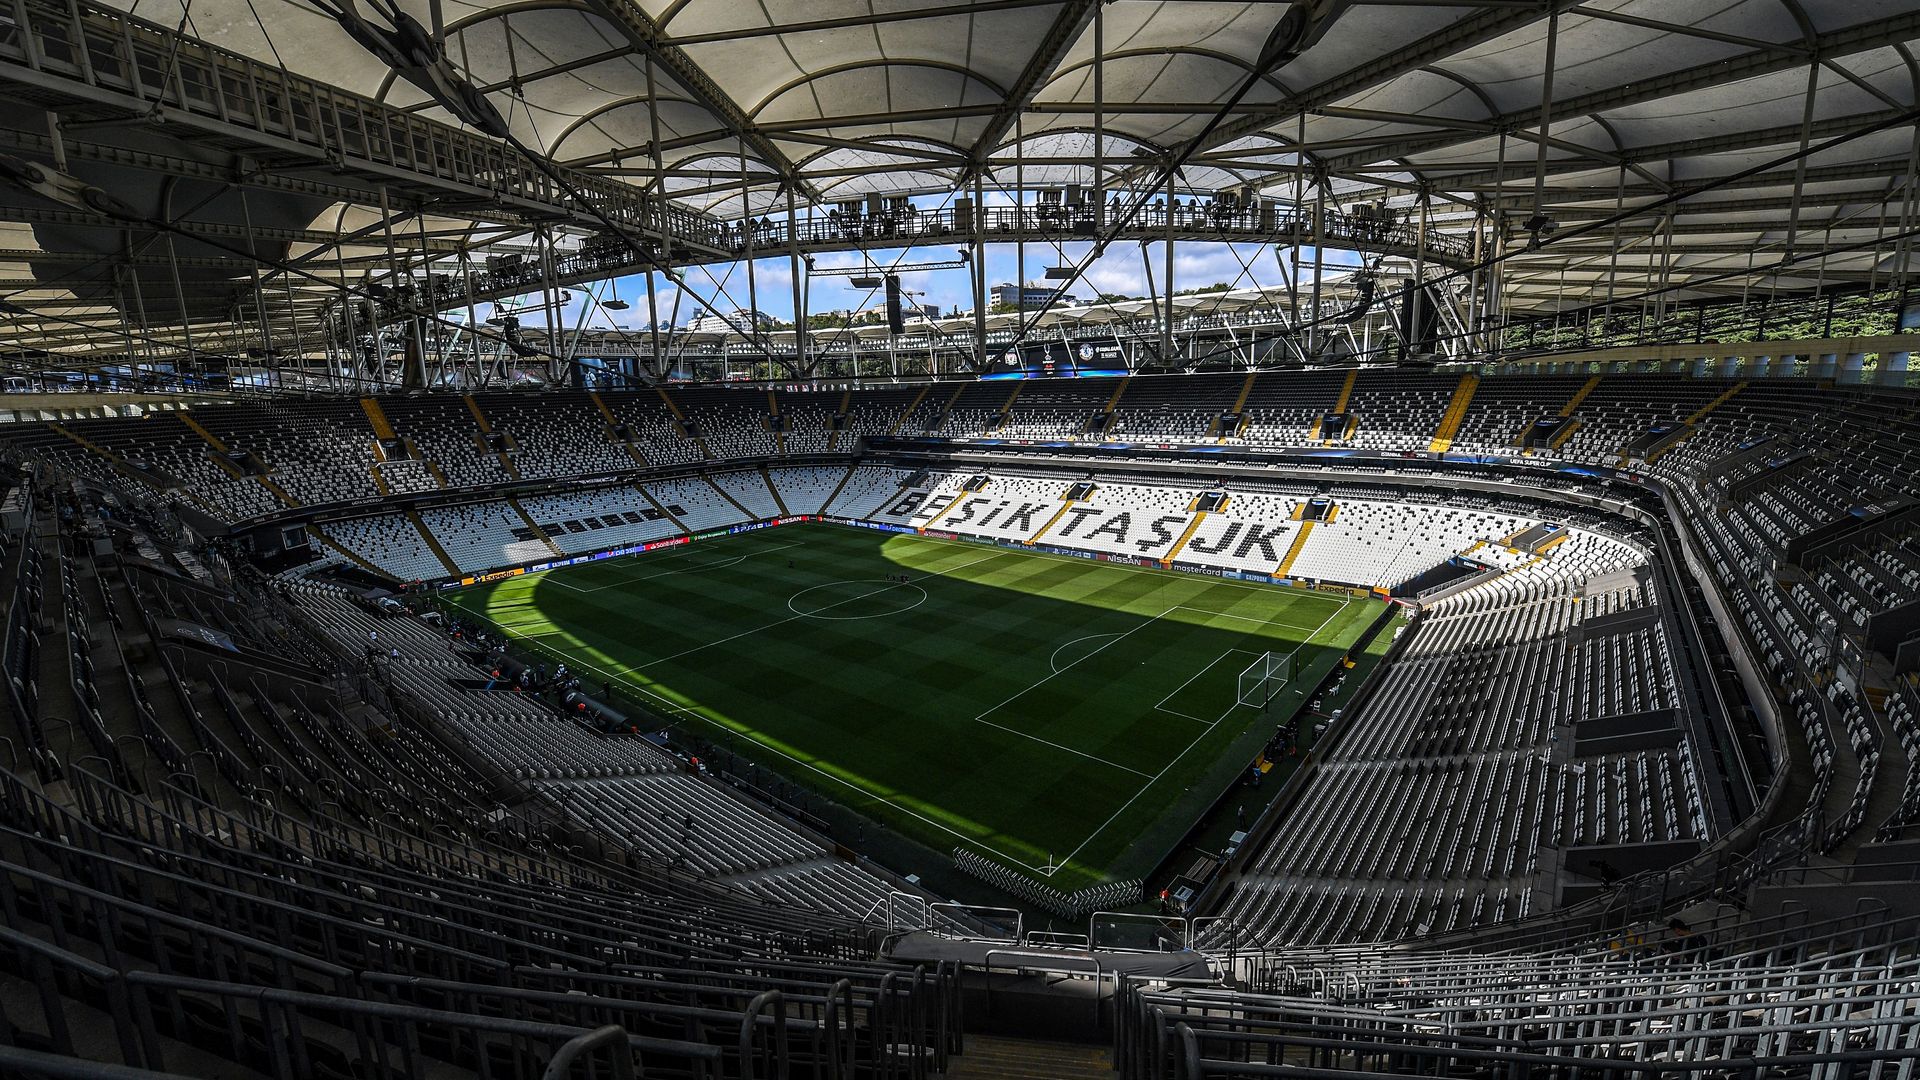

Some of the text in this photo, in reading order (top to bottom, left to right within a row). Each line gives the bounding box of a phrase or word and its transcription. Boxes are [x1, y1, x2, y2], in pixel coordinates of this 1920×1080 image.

[1524, 459, 1540, 467] SUPER
[778, 516, 802, 525] NISSAN
[656, 537, 685, 550] Santander
[1189, 523, 1288, 561] JK
[1061, 549, 1082, 558] PS4
[1107, 555, 1142, 566] NISSAN
[485, 570, 515, 582] Expedia
[1173, 564, 1221, 577] mastercard
[1318, 584, 1355, 596] Expedia
